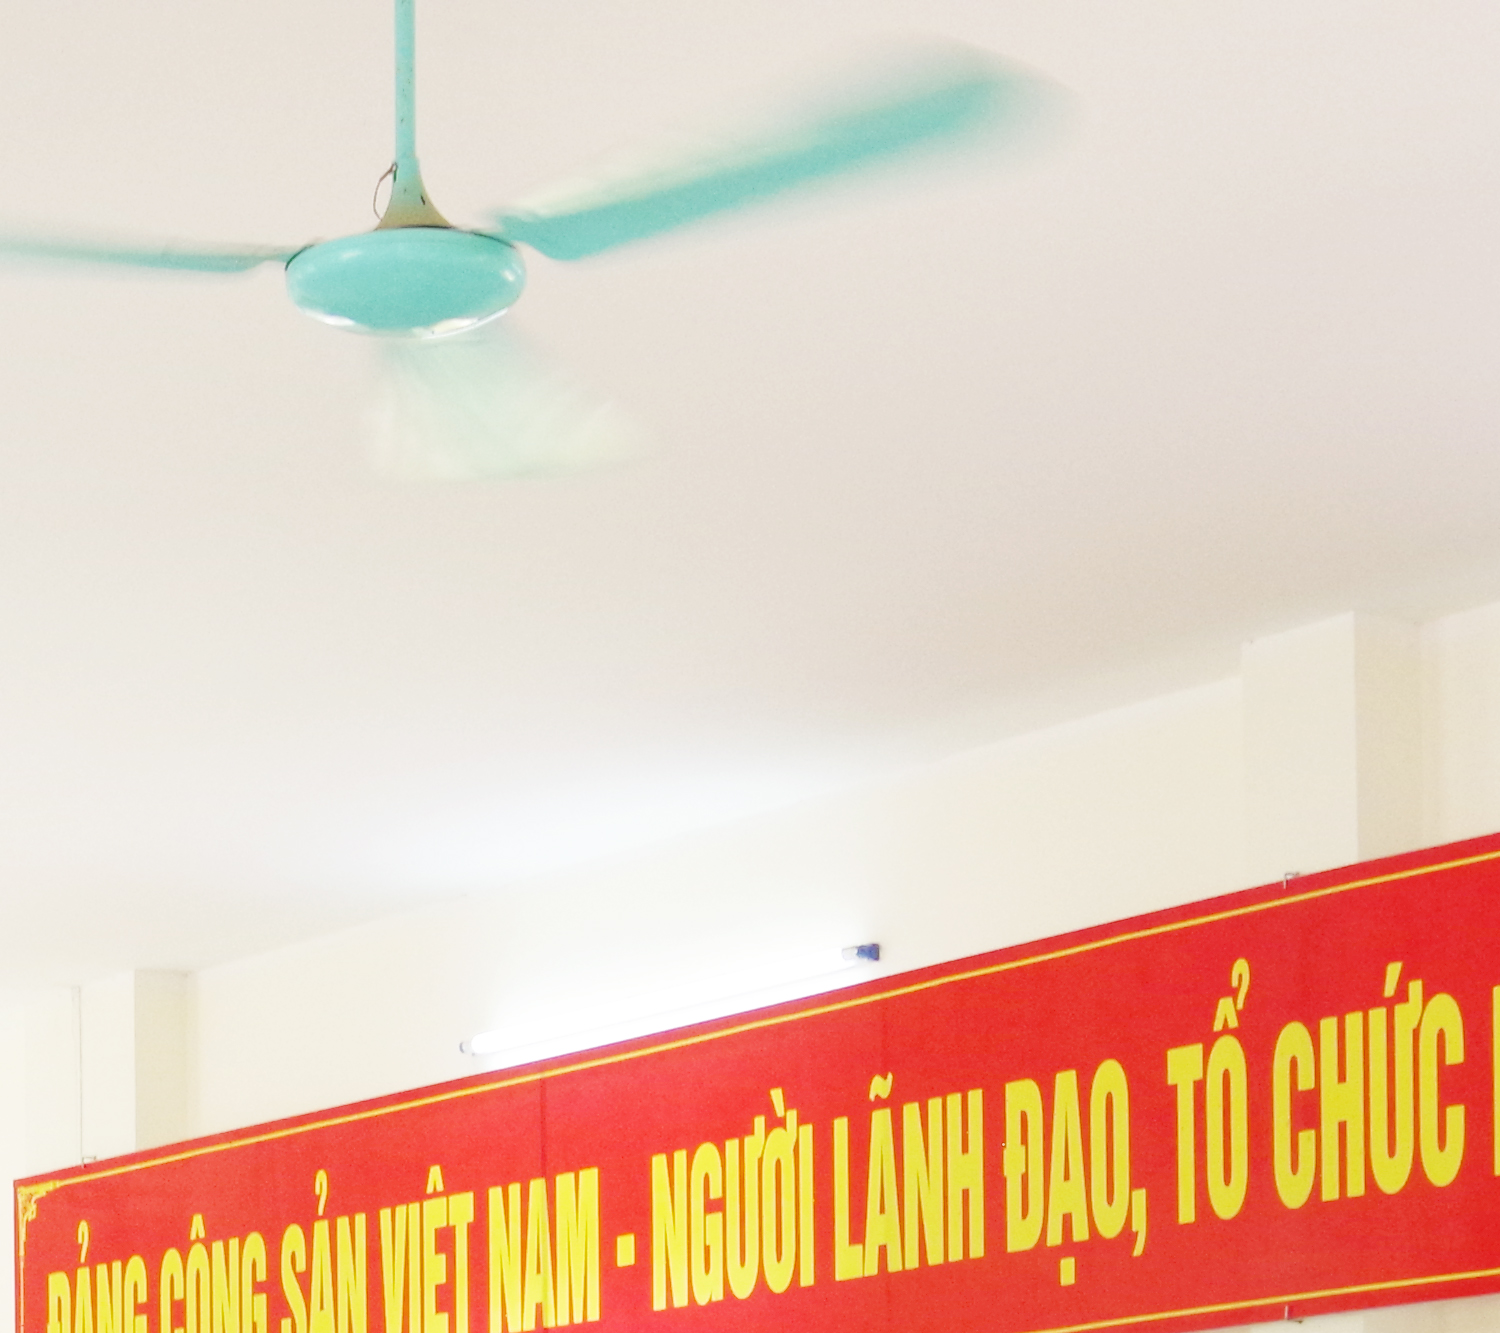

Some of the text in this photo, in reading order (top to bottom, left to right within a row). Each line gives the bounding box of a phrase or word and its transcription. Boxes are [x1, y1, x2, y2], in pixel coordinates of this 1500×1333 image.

[651, 1087, 815, 1312] NGƯỜI
[833, 1072, 985, 1282] LÃNH
[1002, 1058, 1147, 1286] ĐẠO,
[1166, 958, 1250, 1225] TỔ
[1272, 961, 1465, 1210] CHỨC
